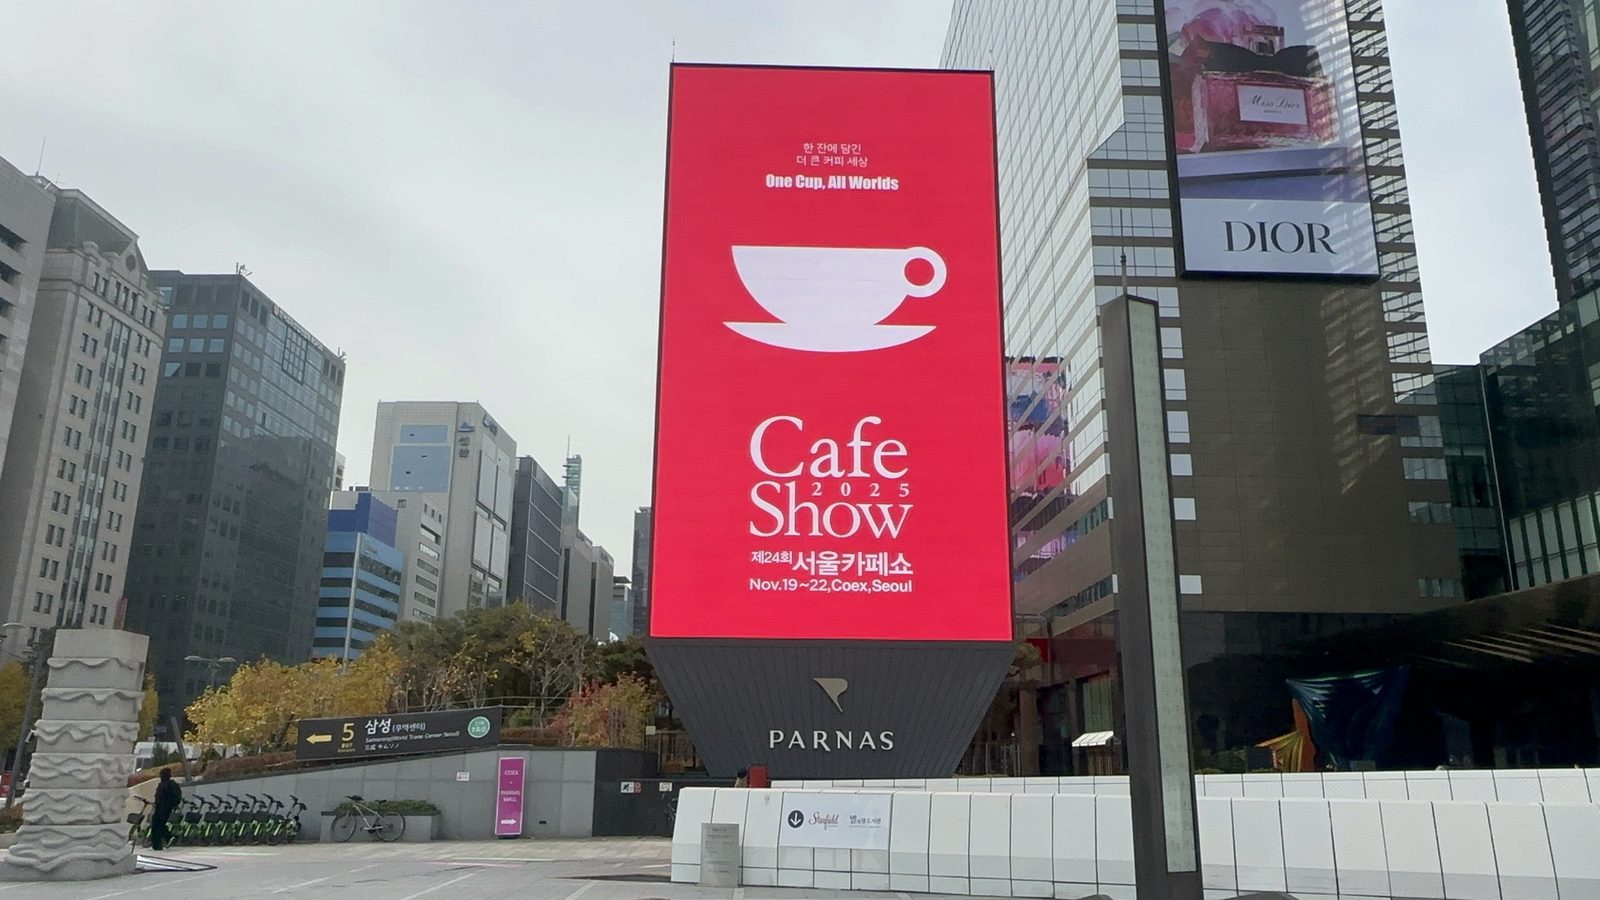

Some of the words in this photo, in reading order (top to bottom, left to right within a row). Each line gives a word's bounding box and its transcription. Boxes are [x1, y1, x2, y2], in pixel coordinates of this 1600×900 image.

[1248, 94, 1274, 107] Miss
[1276, 96, 1300, 109] Dior
[803, 143, 814, 154] 한
[817, 143, 838, 154] 잔에
[841, 143, 861, 155] 담긴
[796, 155, 807, 166] 더
[811, 156, 820, 167] 큰
[823, 156, 844, 167] 커피
[847, 157, 868, 168] 세상
[766, 174, 793, 188] One
[795, 174, 826, 190] Cup,
[827, 175, 847, 190] All
[848, 176, 899, 190] Worlds
[1222, 221, 1338, 255] DIOR
[750, 415, 909, 479] Cafe
[811, 482, 910, 498] 2025
[750, 480, 913, 539] Show
[751, 551, 792, 565] 제24회
[792, 551, 913, 576] 서울카페쇼
[342, 722, 355, 742] 5
[769, 730, 894, 751] PARNAS
[808, 811, 840, 831] Starfield
